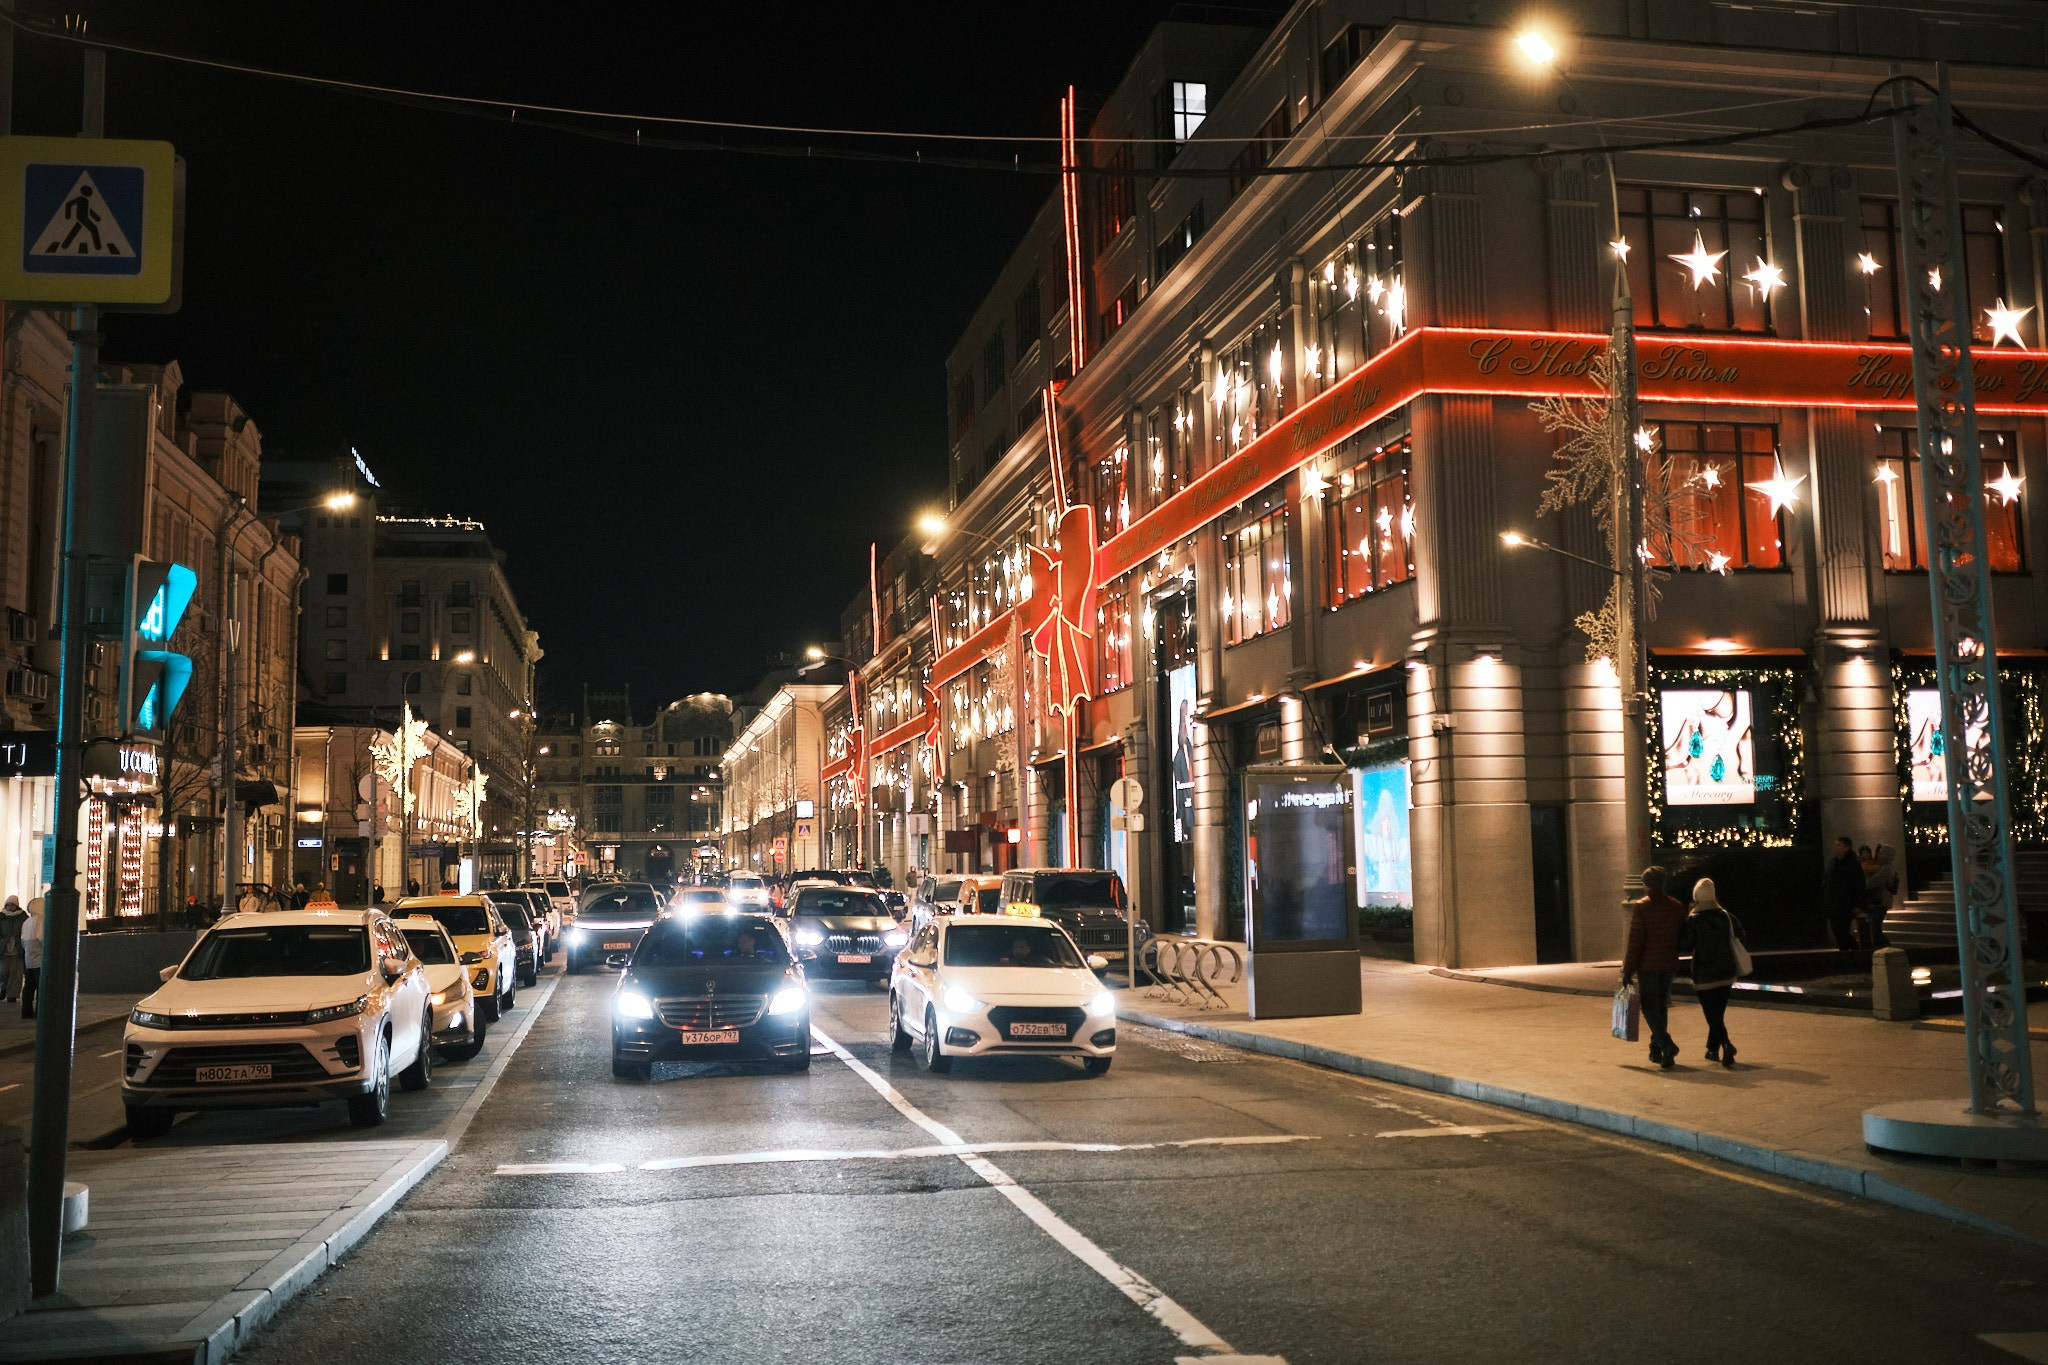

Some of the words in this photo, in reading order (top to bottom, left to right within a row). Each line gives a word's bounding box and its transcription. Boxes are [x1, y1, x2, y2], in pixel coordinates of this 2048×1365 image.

[1468, 337, 1512, 375] С
[1641, 344, 1741, 383] Годом
[1847, 352, 1913, 400] Happ
[1350, 374, 1381, 427] Year
[1, 743, 27, 767] TJ
[1684, 789, 1734, 802] Mercury
[199, 1067, 248, 1081] М802ТА
[250, 1065, 269, 1075] 790
